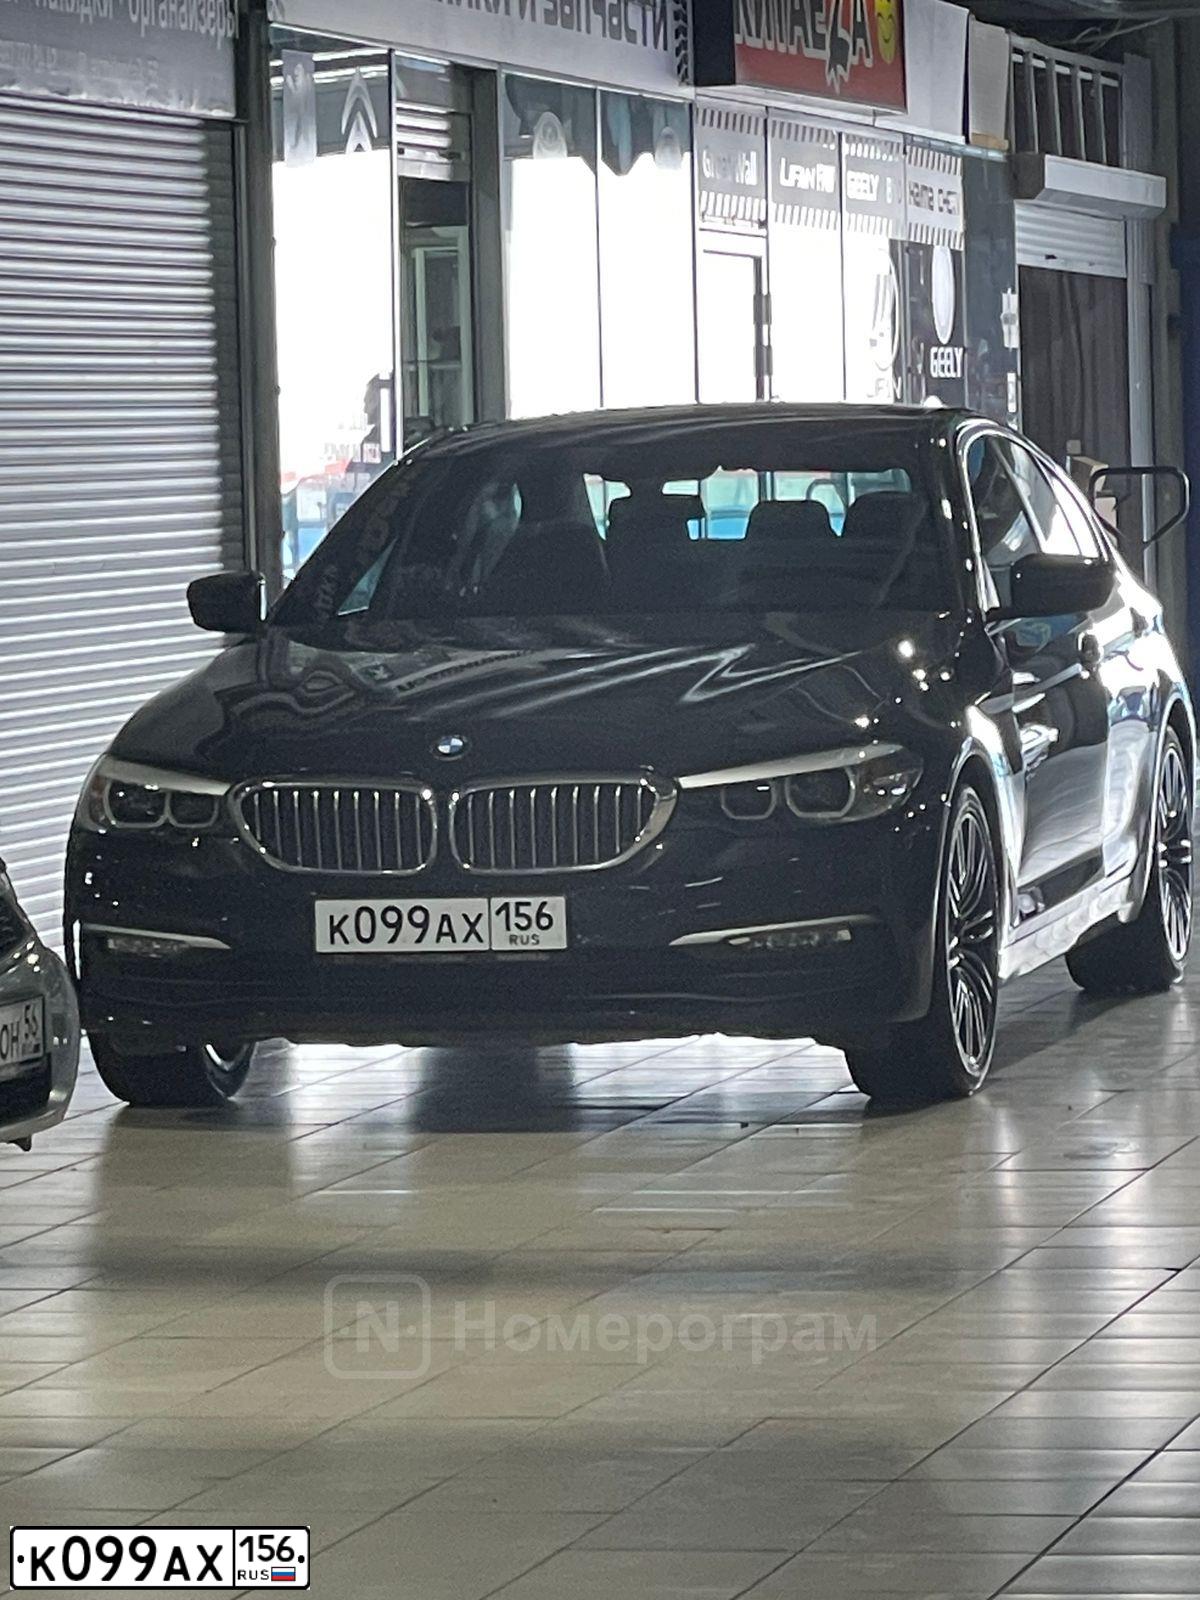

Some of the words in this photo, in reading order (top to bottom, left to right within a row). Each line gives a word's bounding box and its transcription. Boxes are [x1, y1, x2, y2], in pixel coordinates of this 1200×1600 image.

[930, 347, 964, 378] GEELY
[329, 905, 484, 945] К099АХ
[495, 901, 554, 932] 156
[509, 934, 541, 946] RUS
